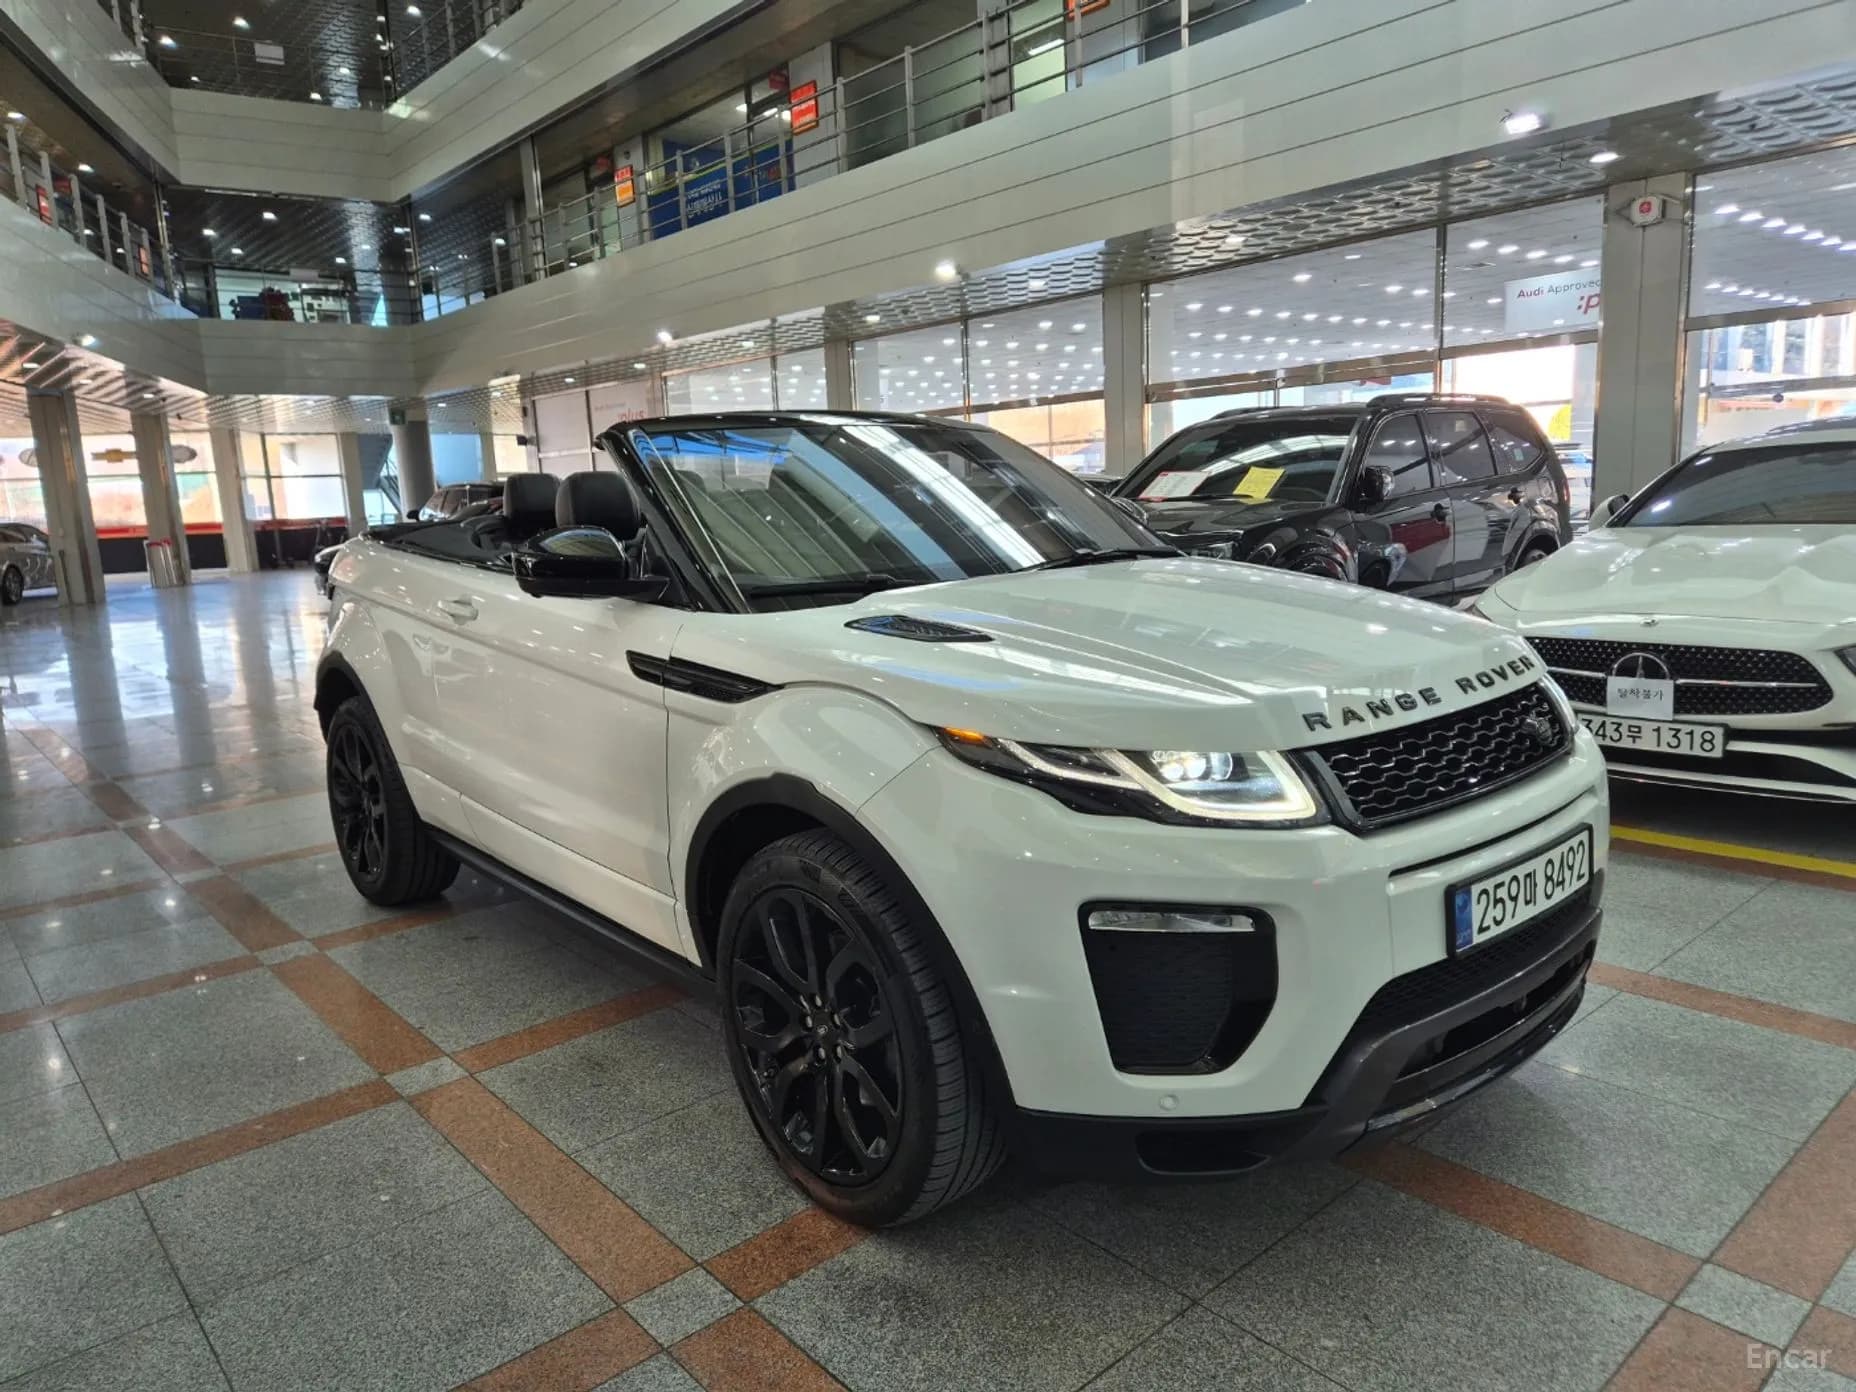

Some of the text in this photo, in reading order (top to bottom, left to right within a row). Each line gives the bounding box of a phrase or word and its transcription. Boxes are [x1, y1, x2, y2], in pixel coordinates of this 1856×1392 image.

[1517, 287, 1544, 299] Audi
[1303, 654, 1536, 732] RANGE ROVER
[1652, 726, 1716, 753] 1318
[1477, 839, 1586, 935] 259마 8492
